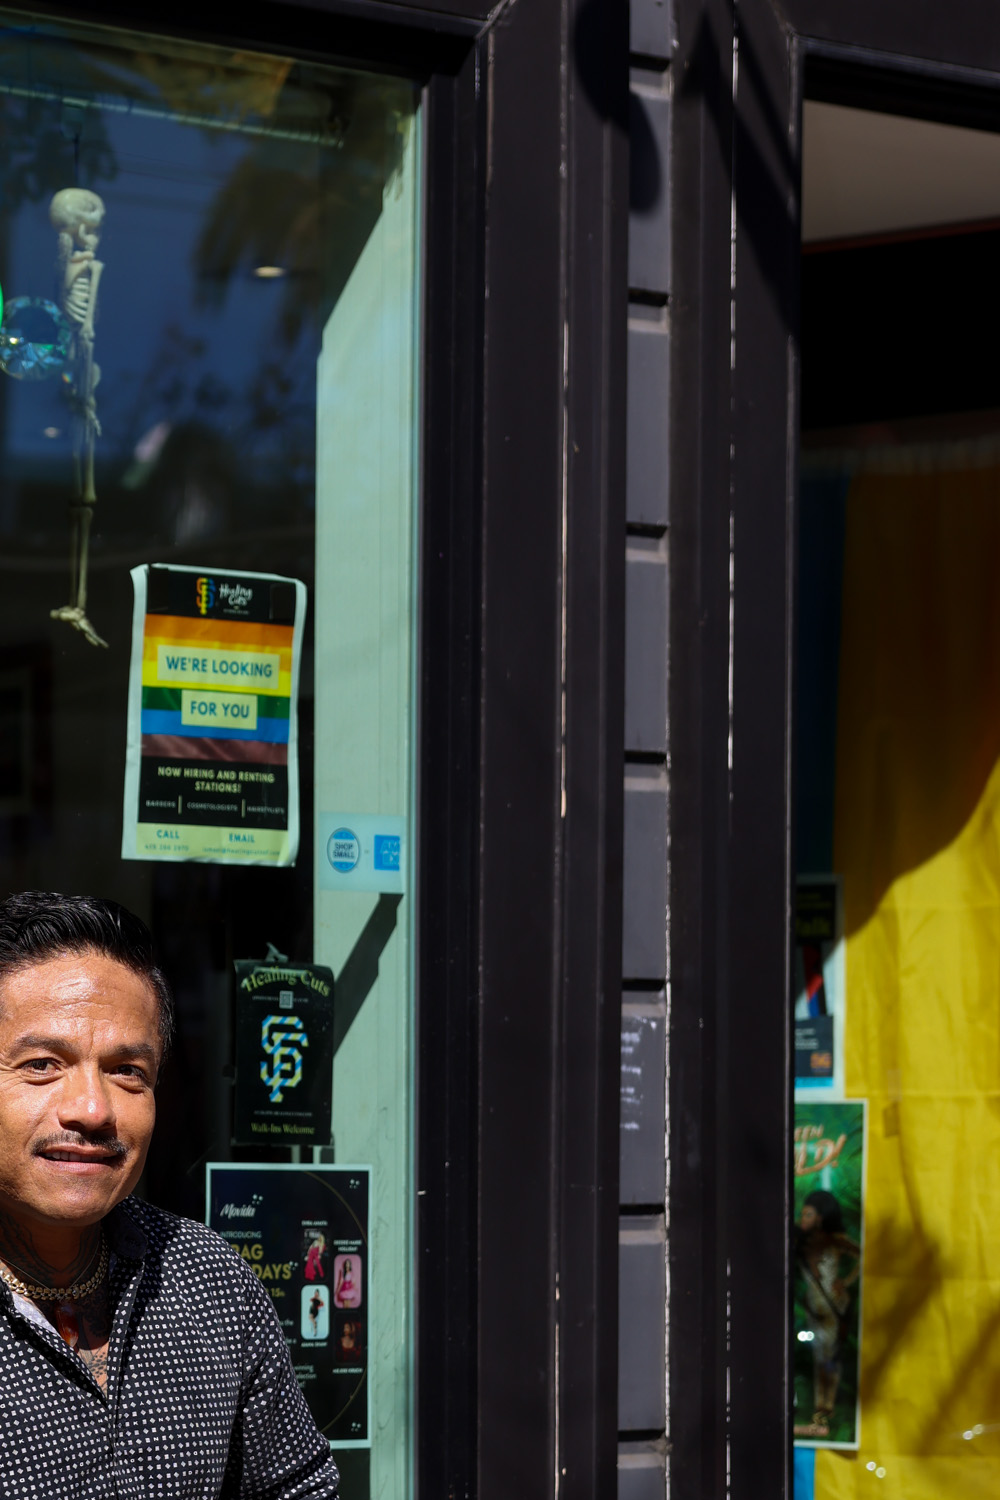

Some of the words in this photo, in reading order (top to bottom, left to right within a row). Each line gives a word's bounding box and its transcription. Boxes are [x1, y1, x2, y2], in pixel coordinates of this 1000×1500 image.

[166, 656, 207, 674] WE'RE
[212, 660, 273, 679] LOOKING
[190, 701, 217, 716] FOR
[221, 703, 250, 718] YOU
[157, 766, 182, 778] NOW
[183, 768, 215, 780] HIRING
[216, 770, 237, 781] AND
[238, 771, 275, 784] RENTING
[194, 781, 242, 794] STATIONS!
[156, 829, 180, 840] CALL
[228, 833, 256, 844] EMAIL
[300, 969, 331, 997] Cuts
[283, 1123, 315, 1136] Welcome
[220, 1203, 257, 1219] Movida
